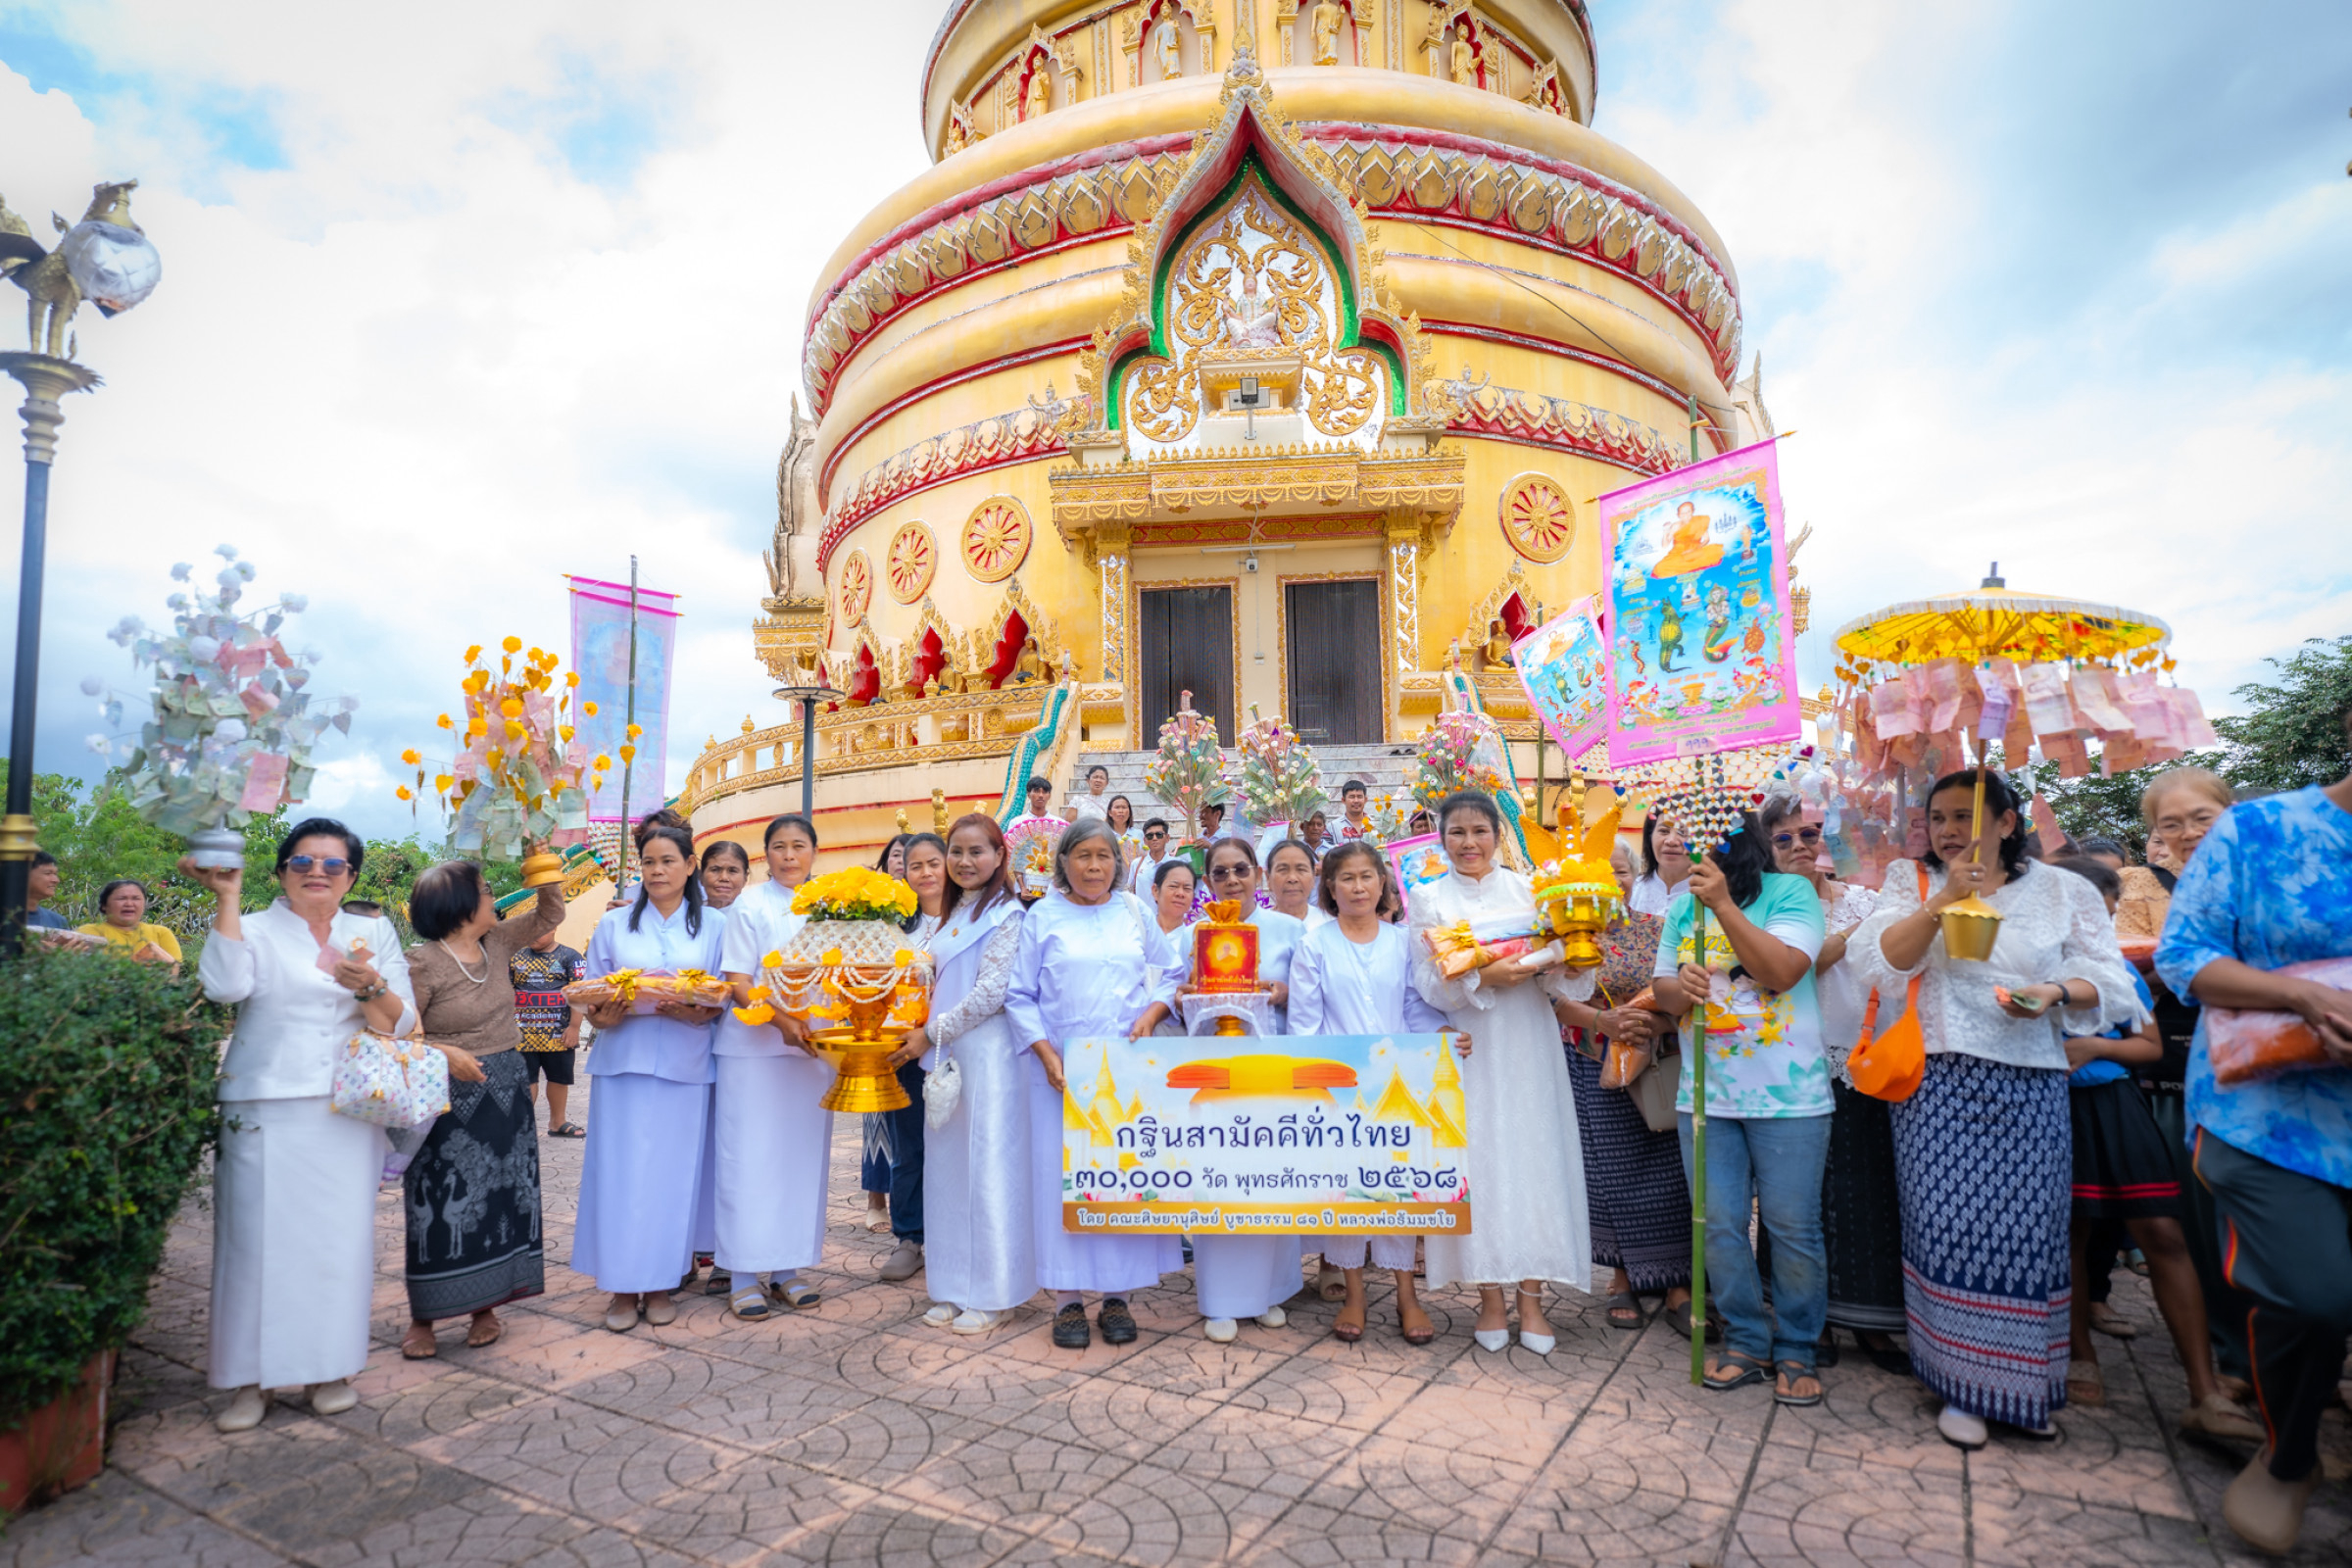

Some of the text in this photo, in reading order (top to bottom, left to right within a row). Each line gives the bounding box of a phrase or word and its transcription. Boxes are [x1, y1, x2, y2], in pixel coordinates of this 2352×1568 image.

[515, 992, 565, 1007] EXTER
[1116, 1105, 1411, 1158] กฐินสามัคคีทั่วไทย
[1075, 1165, 1457, 1196] ๓๐,๐๐๐ วัด พุทธศักราช ๒๕๖๘
[1077, 1208, 1457, 1230] โดย คณะศิษยานุศิษย์ บูชาธรรม ๘๑ ปี หลวงพ่อธัมมชโย
